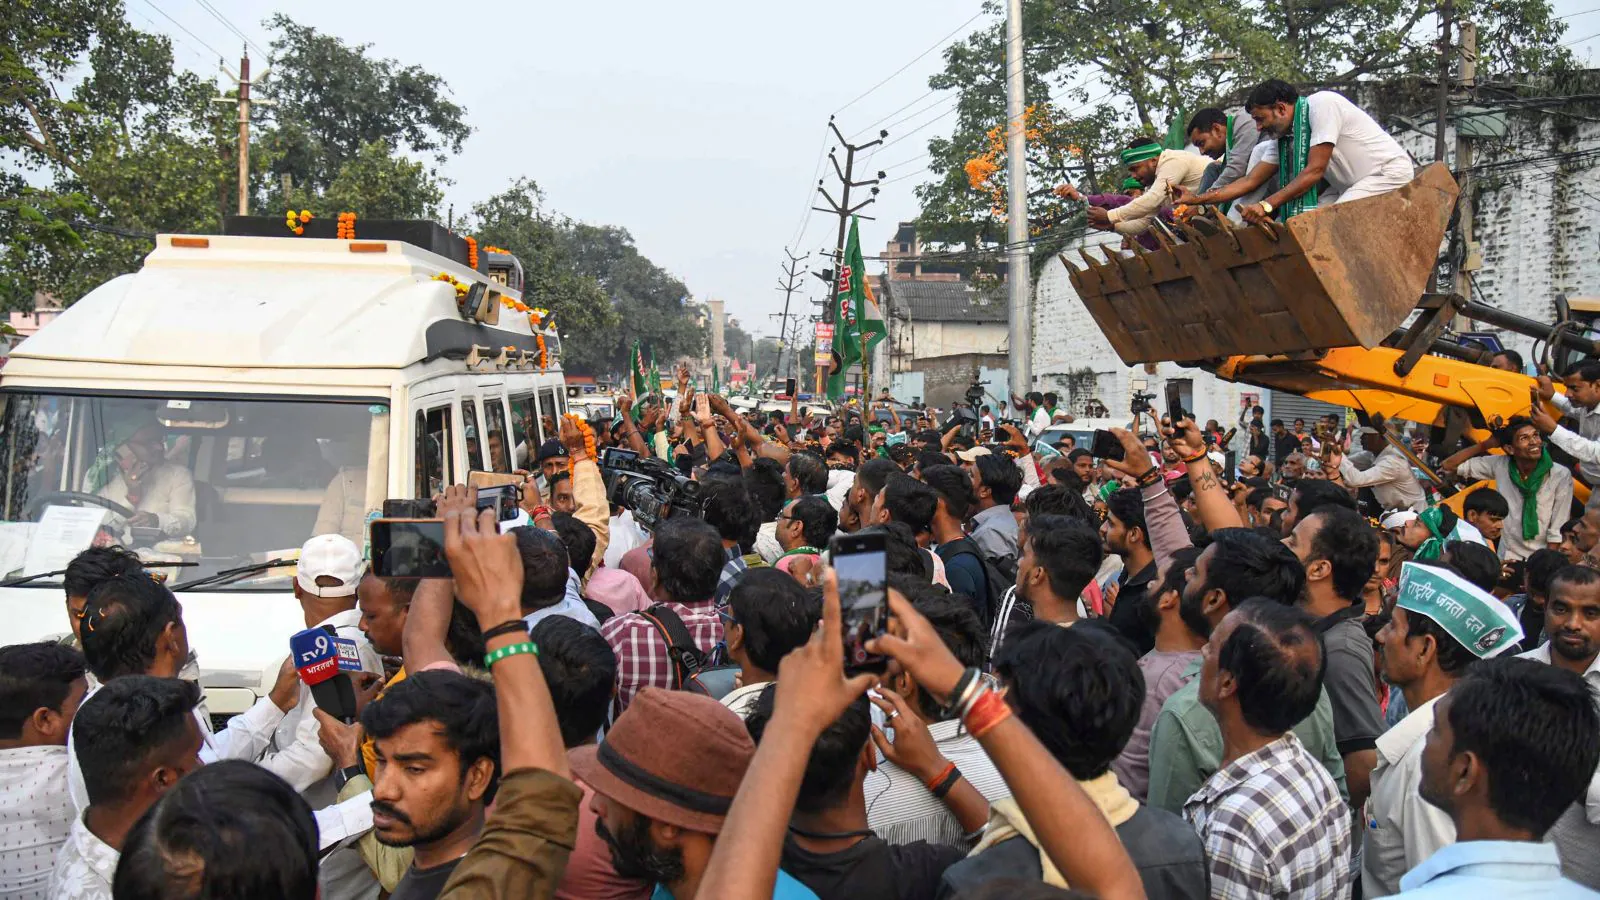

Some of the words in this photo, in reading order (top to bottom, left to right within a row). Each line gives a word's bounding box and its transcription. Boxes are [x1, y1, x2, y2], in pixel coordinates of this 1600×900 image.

[1407, 581, 1436, 601] राष्ट्रीय
[1436, 593, 1466, 619] जनता
[1465, 614, 1486, 635] दल
[306, 656, 335, 674] भारतवर्ष
